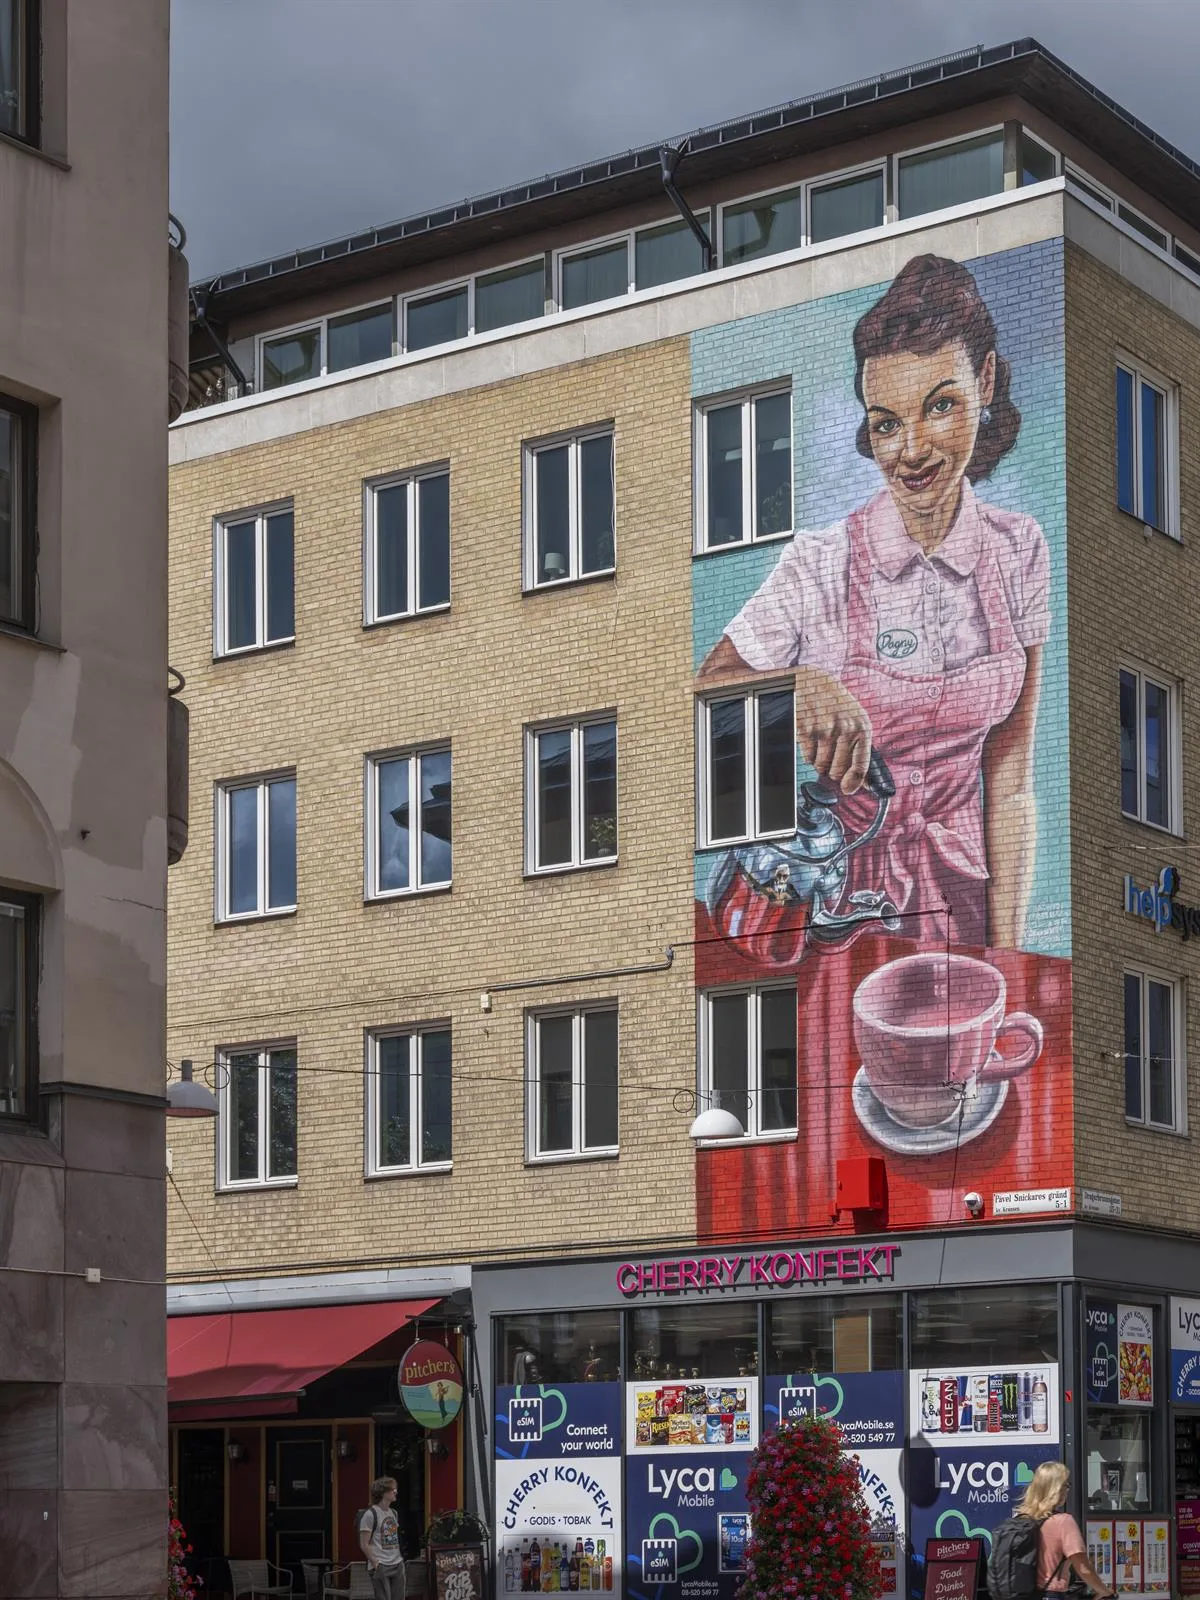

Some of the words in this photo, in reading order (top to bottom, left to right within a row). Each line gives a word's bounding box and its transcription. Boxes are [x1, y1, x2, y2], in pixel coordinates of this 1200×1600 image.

[1014, 1193, 1045, 1202] Snickares
[1048, 1190, 1067, 1201] gränd
[1055, 1199, 1067, 1208] 5-1
[616, 1256, 742, 1293] CHERRY
[750, 1245, 899, 1283] KONFEKT
[1177, 1356, 1197, 1397] CHERRY
[788, 1407, 808, 1416] eSIM
[517, 1417, 535, 1426] eSIM
[837, 1420, 894, 1432] LycaMobile.se
[566, 1424, 608, 1436] Connect
[868, 1433, 883, 1443] 549
[885, 1433, 895, 1443] 77
[561, 1441, 583, 1453] your
[585, 1437, 613, 1450] world
[648, 1463, 715, 1498] Lyca
[935, 1457, 1009, 1494] Lyca
[504, 1467, 548, 1529] CHERRY
[554, 1466, 613, 1529] KONFEKT
[857, 1463, 896, 1525] NFEKT
[967, 1489, 1009, 1503] Mobile
[677, 1494, 715, 1507] Mobile
[529, 1516, 556, 1526] GODIS
[563, 1516, 591, 1525] TOBAK
[937, 1541, 971, 1557] pitcher's
[650, 1558, 669, 1567] eSIM
[940, 1567, 962, 1580] Food
[681, 1580, 719, 1588] LycaMobile.se
[701, 1588, 712, 1596] 549
[712, 1588, 719, 1596] 77
